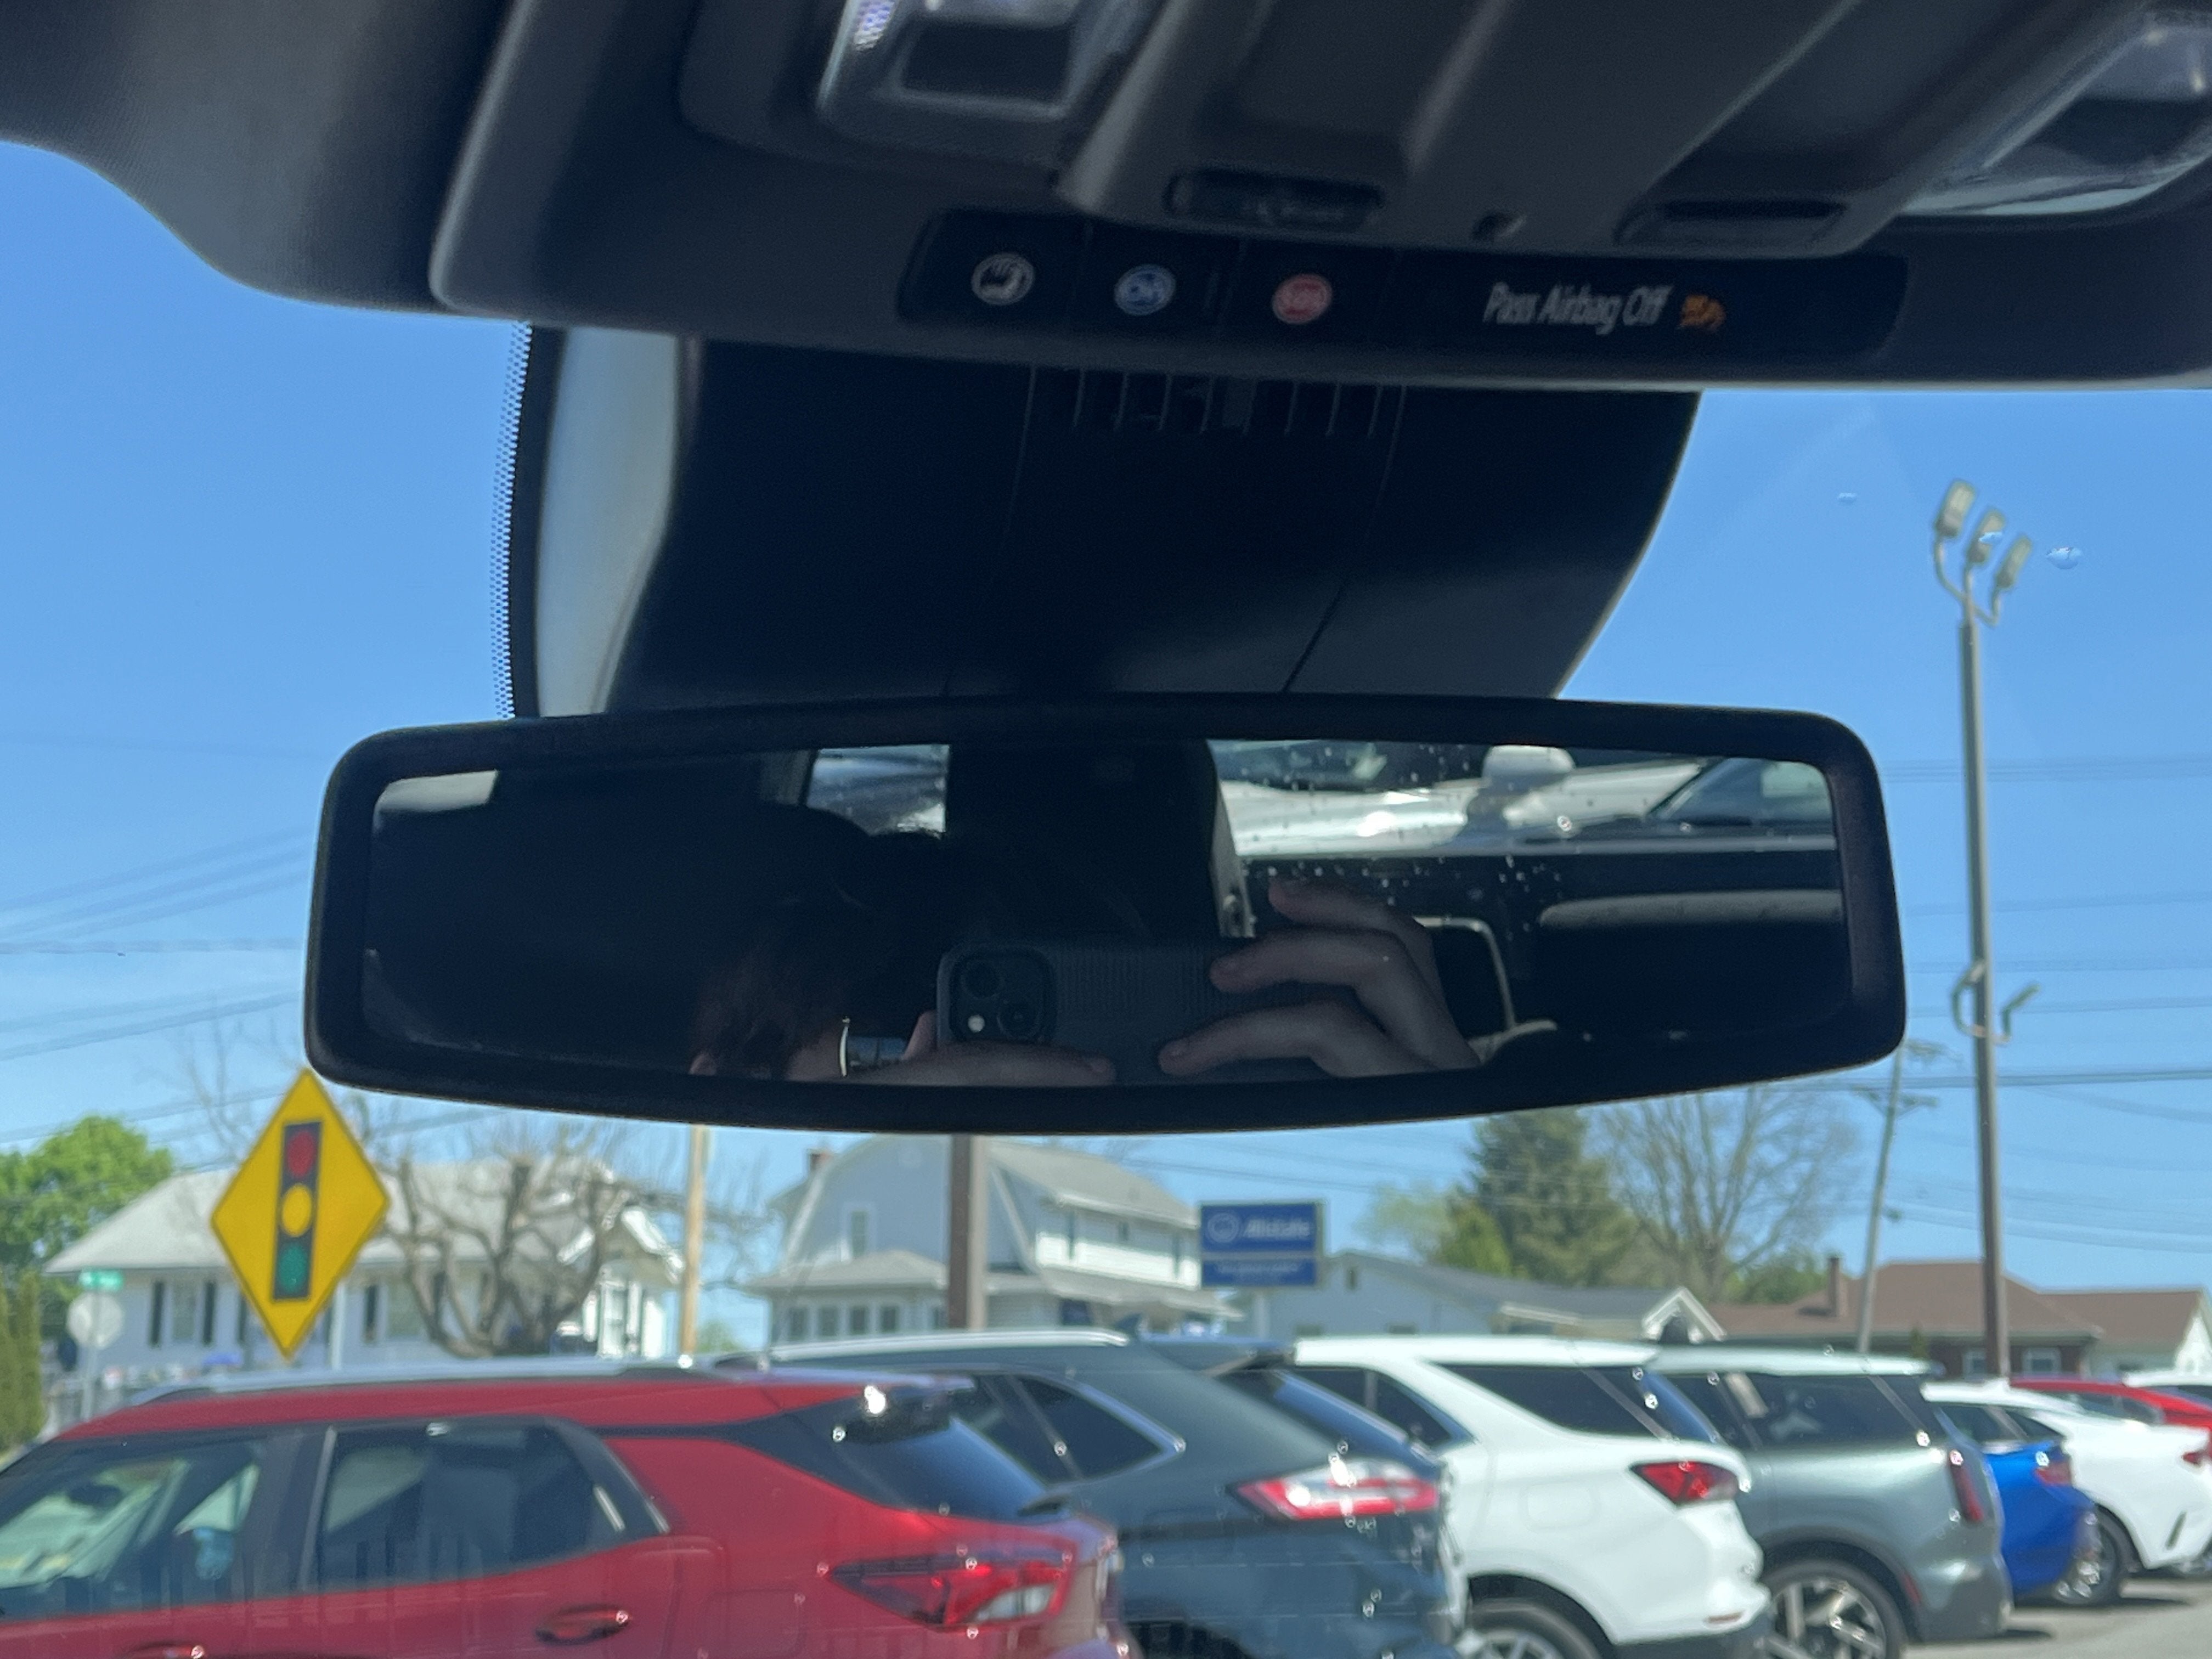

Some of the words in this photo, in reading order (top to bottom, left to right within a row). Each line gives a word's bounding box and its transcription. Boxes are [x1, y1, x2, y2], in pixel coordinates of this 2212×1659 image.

[1483, 282, 1537, 324] Pass
[1537, 283, 1623, 335] Airbag
[1622, 285, 1673, 326] Off
